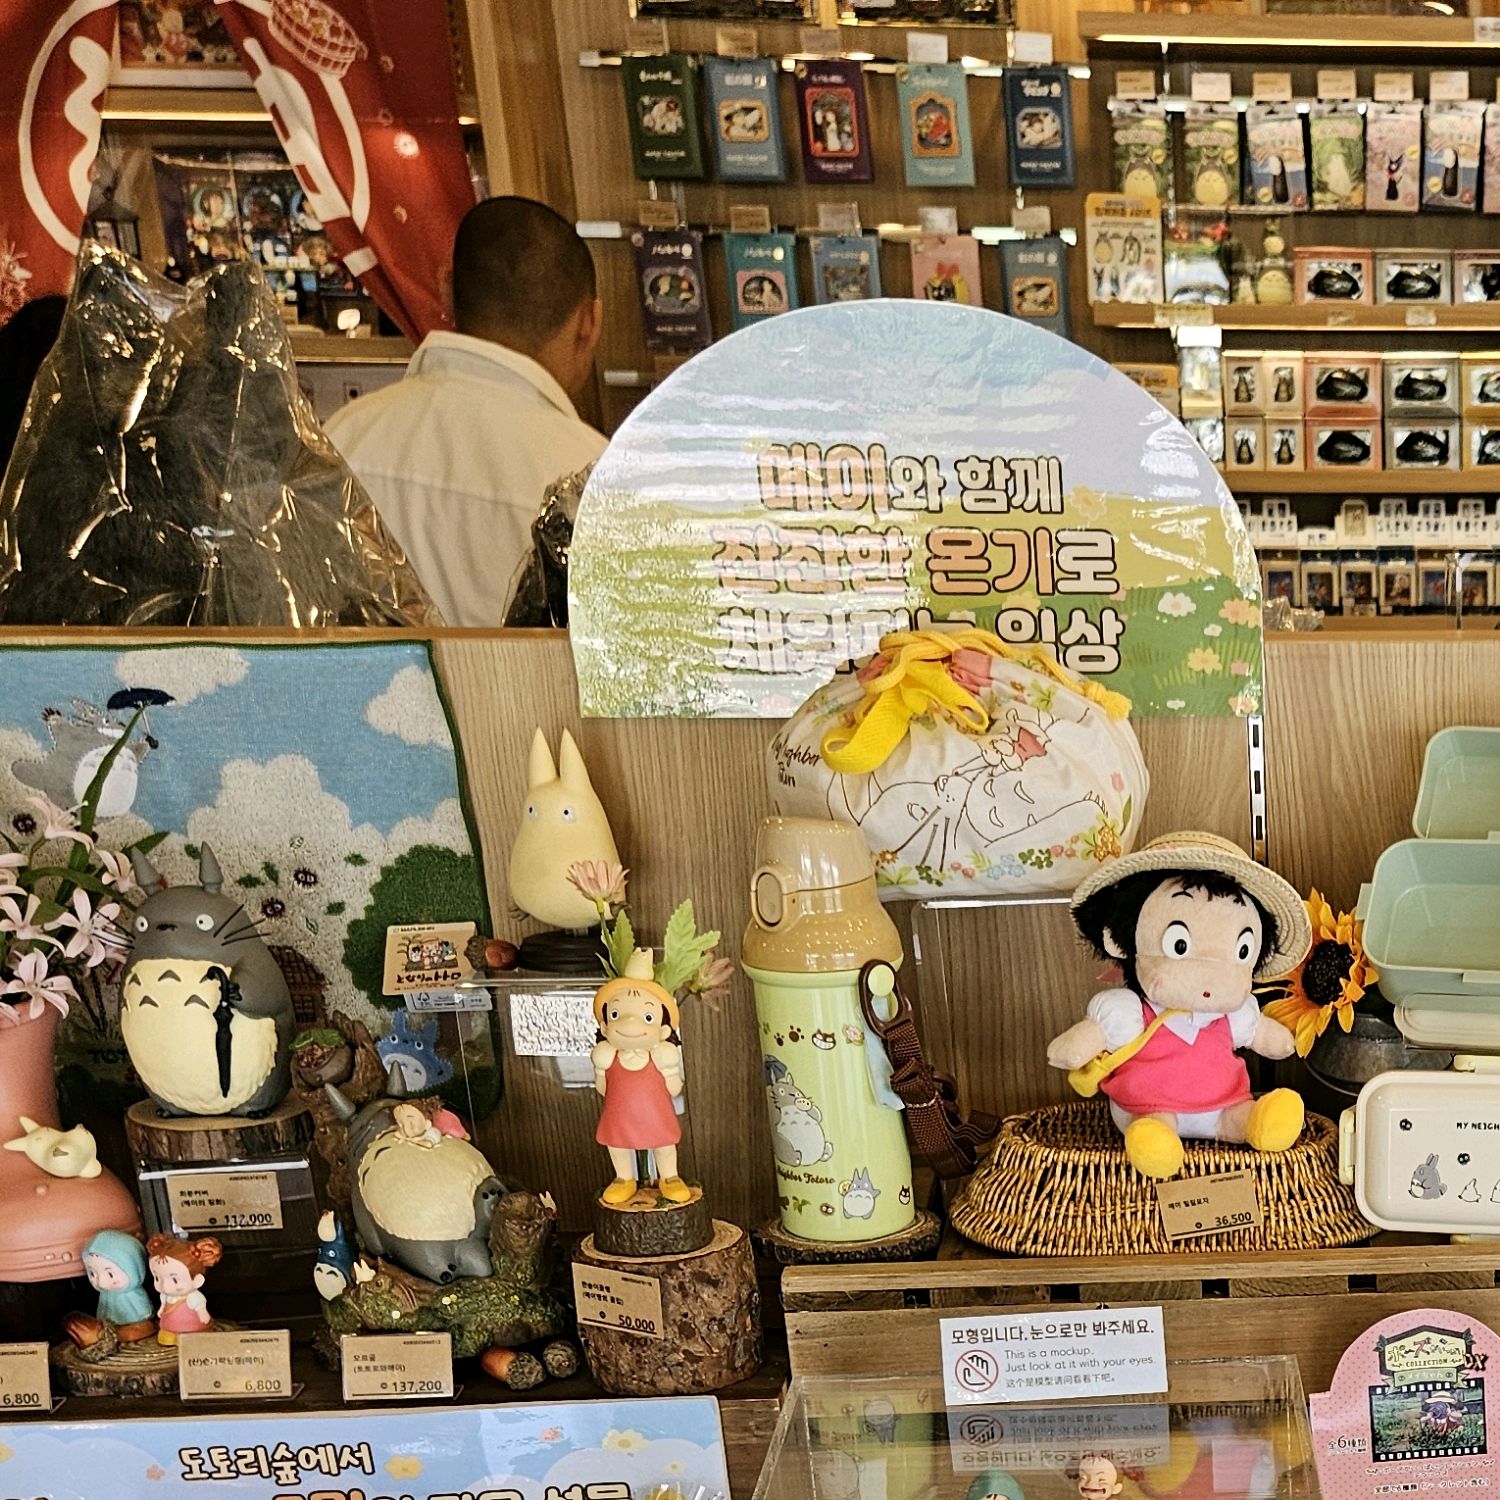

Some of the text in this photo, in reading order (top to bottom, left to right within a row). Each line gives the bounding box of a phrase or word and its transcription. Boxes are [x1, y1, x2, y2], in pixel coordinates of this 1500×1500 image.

[756, 442, 1065, 515] 메이와 함께
[926, 526, 1121, 596] 온기로
[1456, 1122, 1469, 1130] MY
[803, 1173, 836, 1185] Totoro
[1215, 1212, 1252, 1227] 36,500
[619, 1314, 655, 1331] 50,000
[952, 1318, 1155, 1345] 모형입니다. 눈으로만 봐주세요.
[1005, 1349, 1025, 1360] This
[1028, 1348, 1038, 1358] is
[1050, 1347, 1094, 1359] mockup.
[1463, 1352, 1489, 1371] DX
[1005, 1355, 1157, 1373] Just look at it with your eyes.
[1405, 1358, 1448, 1368] COLLECTION
[245, 1380, 282, 1393] 6,800
[392, 1380, 442, 1394] 137,200
[178, 1442, 375, 1485] 도토리숲에서
